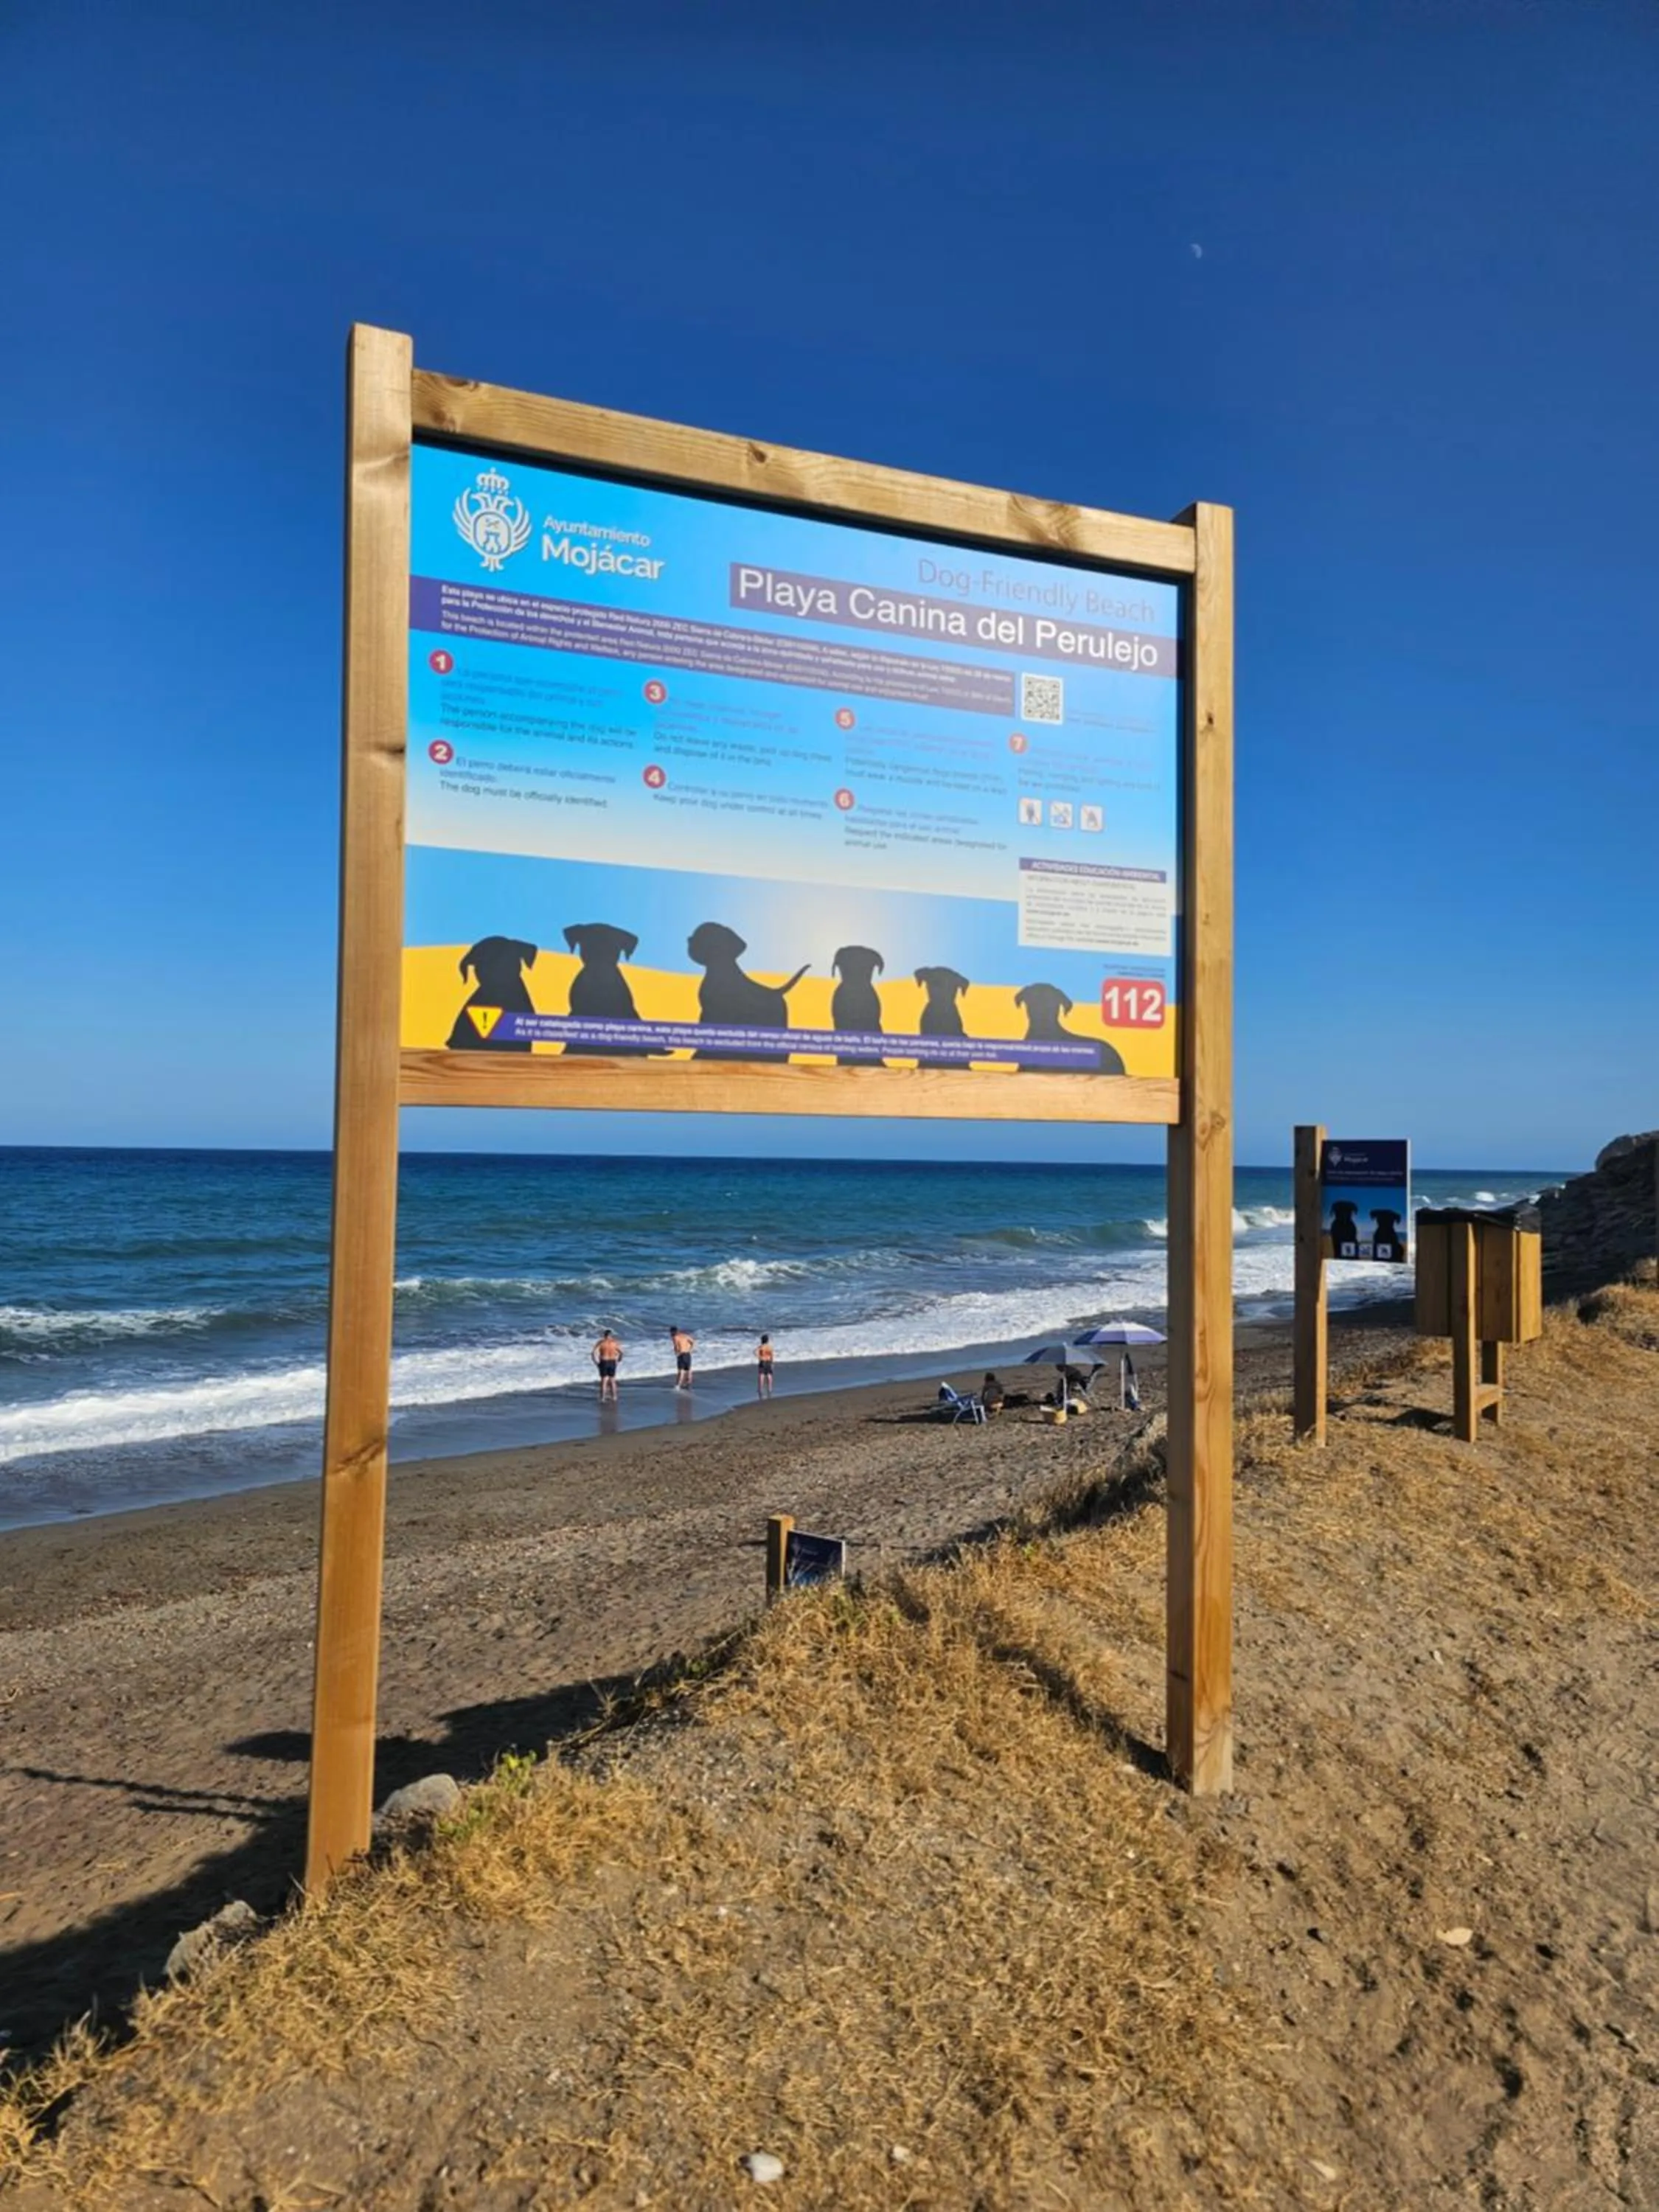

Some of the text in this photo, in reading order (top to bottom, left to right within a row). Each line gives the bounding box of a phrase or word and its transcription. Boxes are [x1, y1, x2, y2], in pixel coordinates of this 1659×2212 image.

[543, 515, 650, 547] Ayuntamiento
[540, 534, 666, 580] Mojácar
[917, 558, 1156, 622] Dog-Friendly Beach
[738, 568, 838, 616] Playa
[848, 587, 967, 637] Canina
[976, 609, 1023, 645] del
[1034, 620, 1158, 670] Perulejo
[435, 654, 446, 671] 1
[648, 684, 662, 700] 3
[839, 710, 852, 728] 5
[1012, 735, 1023, 751] 7
[434, 744, 448, 761] 2
[647, 770, 662, 786] 4
[1105, 985, 1163, 1023] 112
